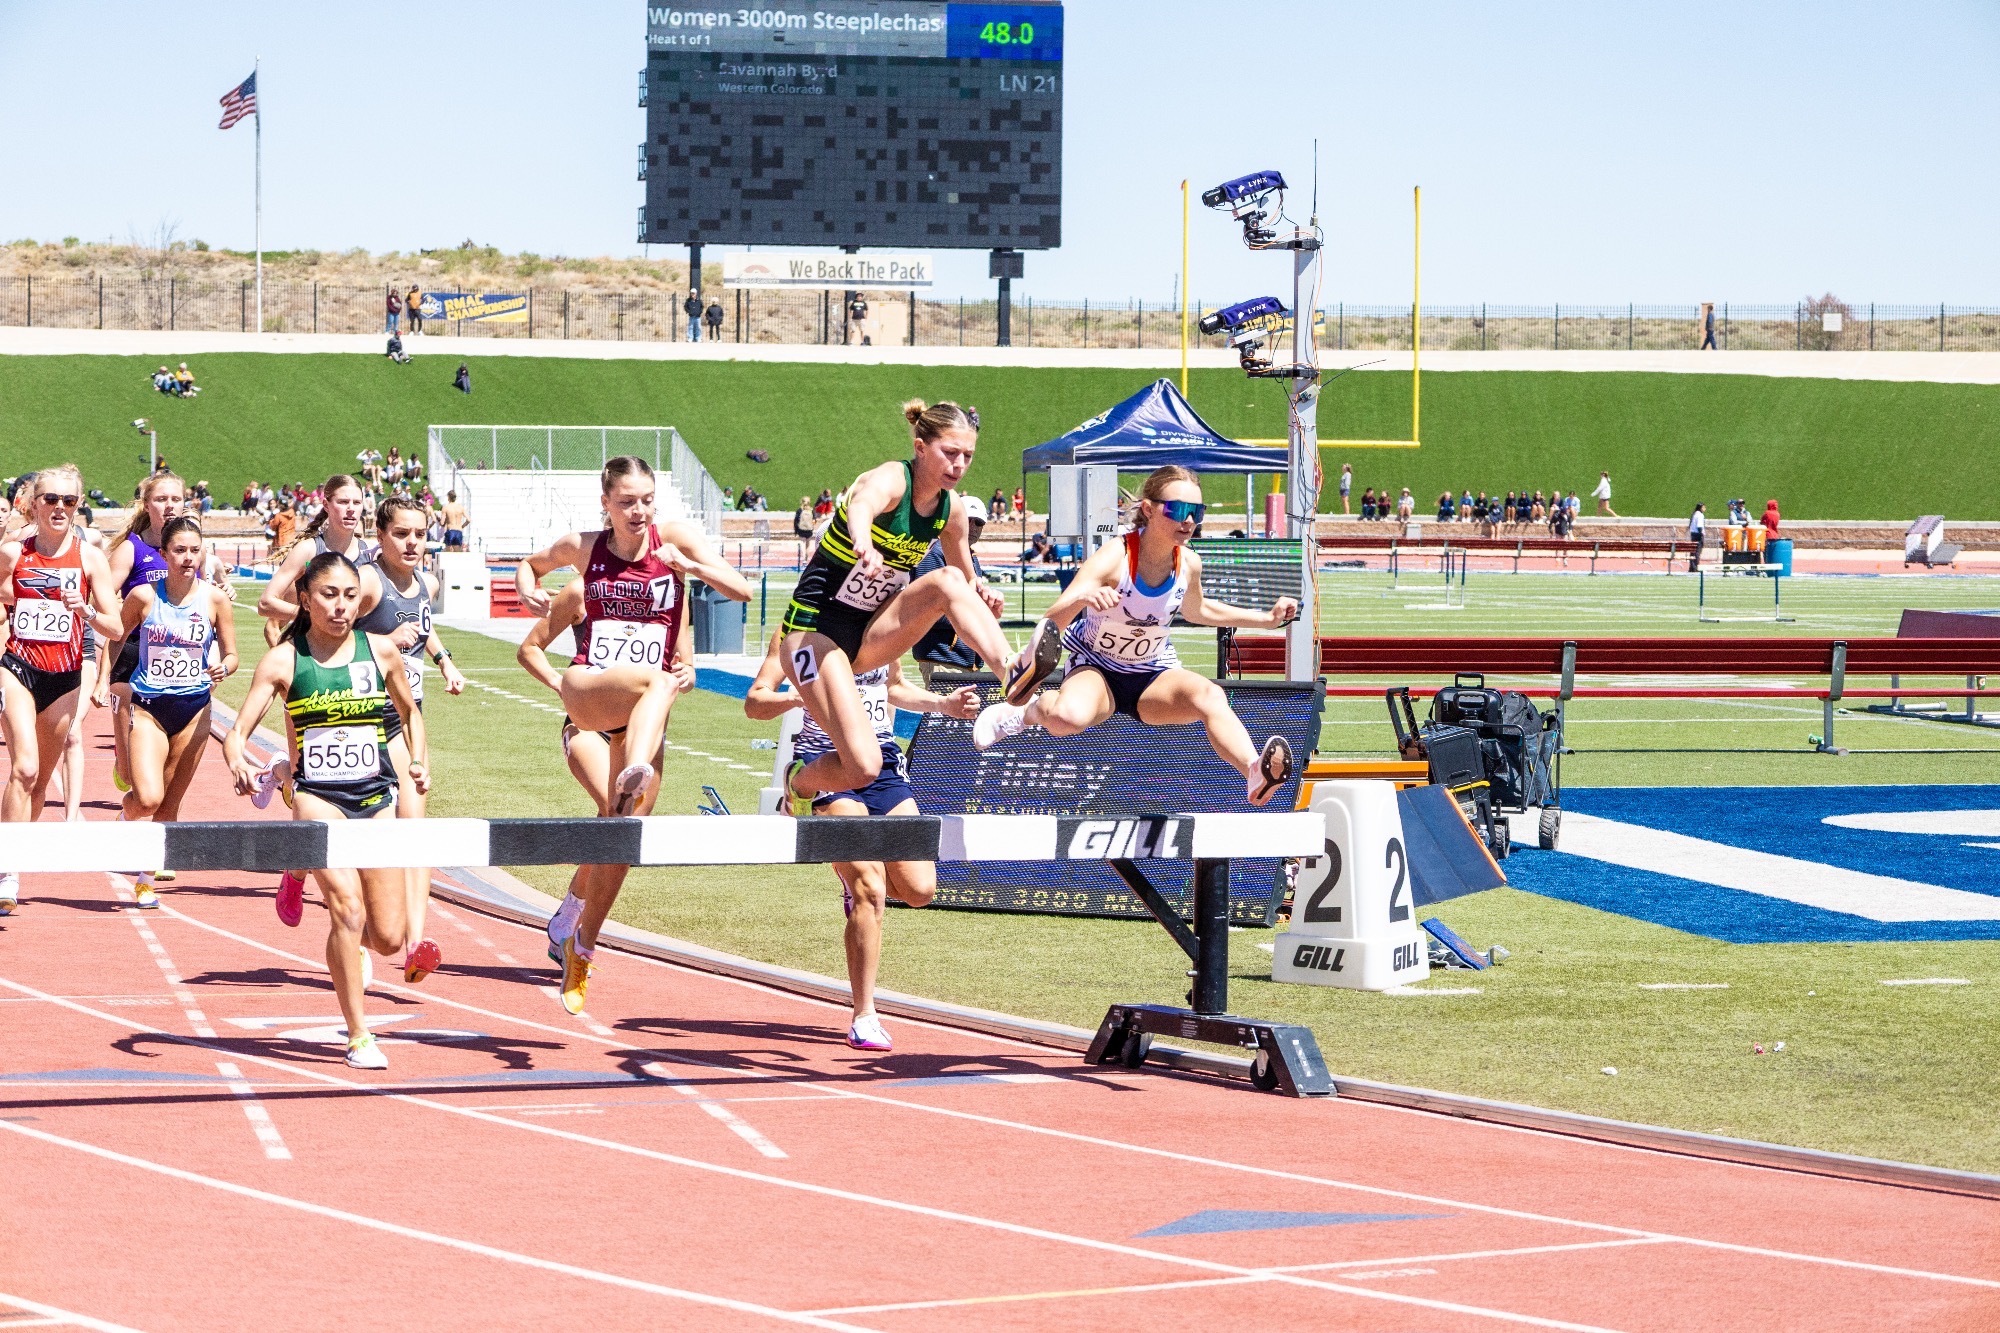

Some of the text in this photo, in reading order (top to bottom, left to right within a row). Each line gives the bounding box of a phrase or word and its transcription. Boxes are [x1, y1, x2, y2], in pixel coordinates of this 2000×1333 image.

[648, 8, 731, 27] Women
[737, 10, 807, 28] 3000m
[648, 34, 711, 45] Heat 1 of 1
[980, 22, 1034, 45] 48.0
[718, 62, 797, 77] Savannah
[718, 83, 823, 95] Western Colorado
[1000, 75, 1056, 93] LN 21
[1248, 176, 1268, 188] LYNX
[789, 260, 925, 280] We Back The Pack
[444, 294, 485, 311] RMAC
[1096, 524, 1114, 533] GILL
[881, 533, 929, 551] Adam
[892, 551, 925, 566] Sta
[65, 570, 77, 590] 8
[846, 571, 903, 603] 555
[584, 581, 681, 602] OLORAO
[654, 578, 670, 609] 7
[602, 600, 659, 617] MESA
[17, 611, 70, 633] 6126
[422, 606, 431, 633] 6
[147, 623, 168, 644] CSU
[189, 623, 205, 642] 13
[593, 636, 661, 665] 5790
[1098, 631, 1166, 657] 5707
[150, 658, 200, 678] 5828
[794, 650, 815, 682] 2
[358, 664, 372, 694] 3
[303, 688, 354, 714] Adam
[327, 699, 375, 722] State
[308, 743, 375, 769] 5550
[1067, 819, 1180, 859] GILL
[1304, 837, 1342, 923] 2
[1385, 837, 1409, 923] 2
[1292, 944, 1346, 973] GILL
[1392, 941, 1420, 972] GILL
